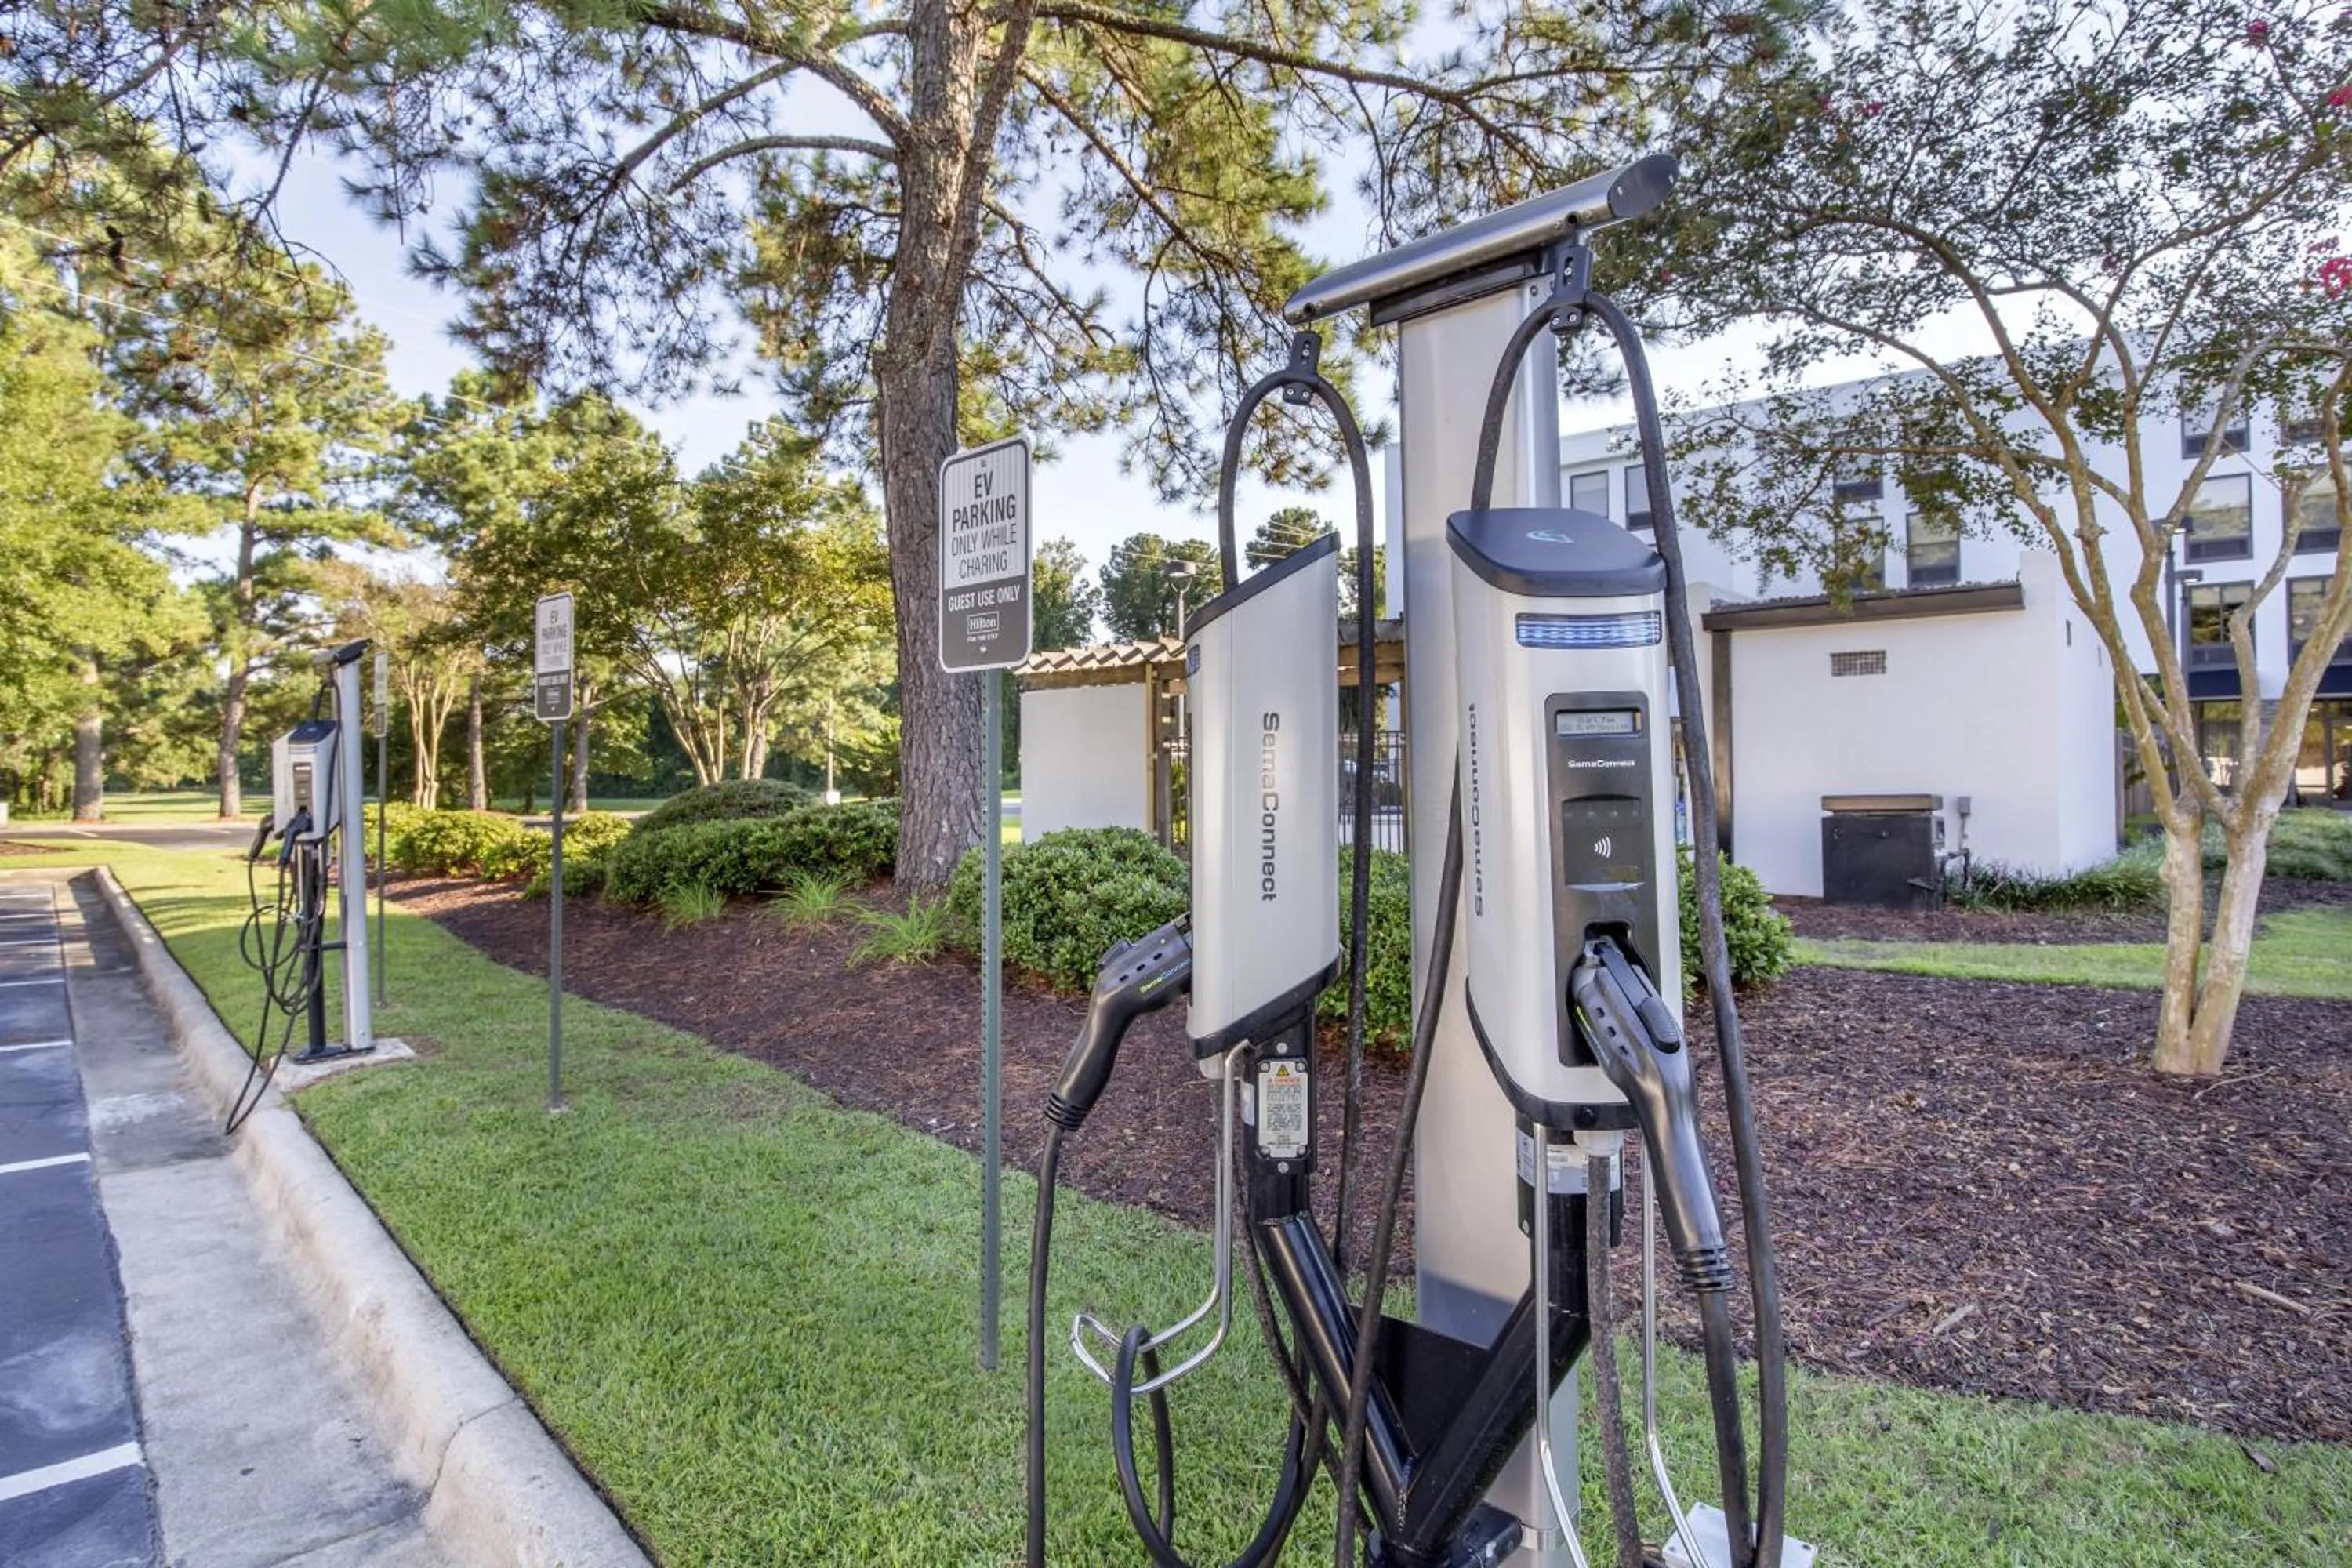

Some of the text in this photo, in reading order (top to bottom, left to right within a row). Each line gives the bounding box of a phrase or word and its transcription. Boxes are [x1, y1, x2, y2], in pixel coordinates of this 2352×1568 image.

[975, 470, 993, 499] EV
[953, 494, 1016, 532] PARKING
[952, 523, 1017, 556] ONLY WHILE
[959, 550, 1007, 579] CHARING
[948, 584, 1020, 612] GUEST USE ONLY
[970, 617, 996, 630] Hilton
[1567, 760, 1635, 768] SemaConnect
[1261, 712, 1280, 902] SemaConnect
[1468, 702, 1483, 917] SemaConnect
